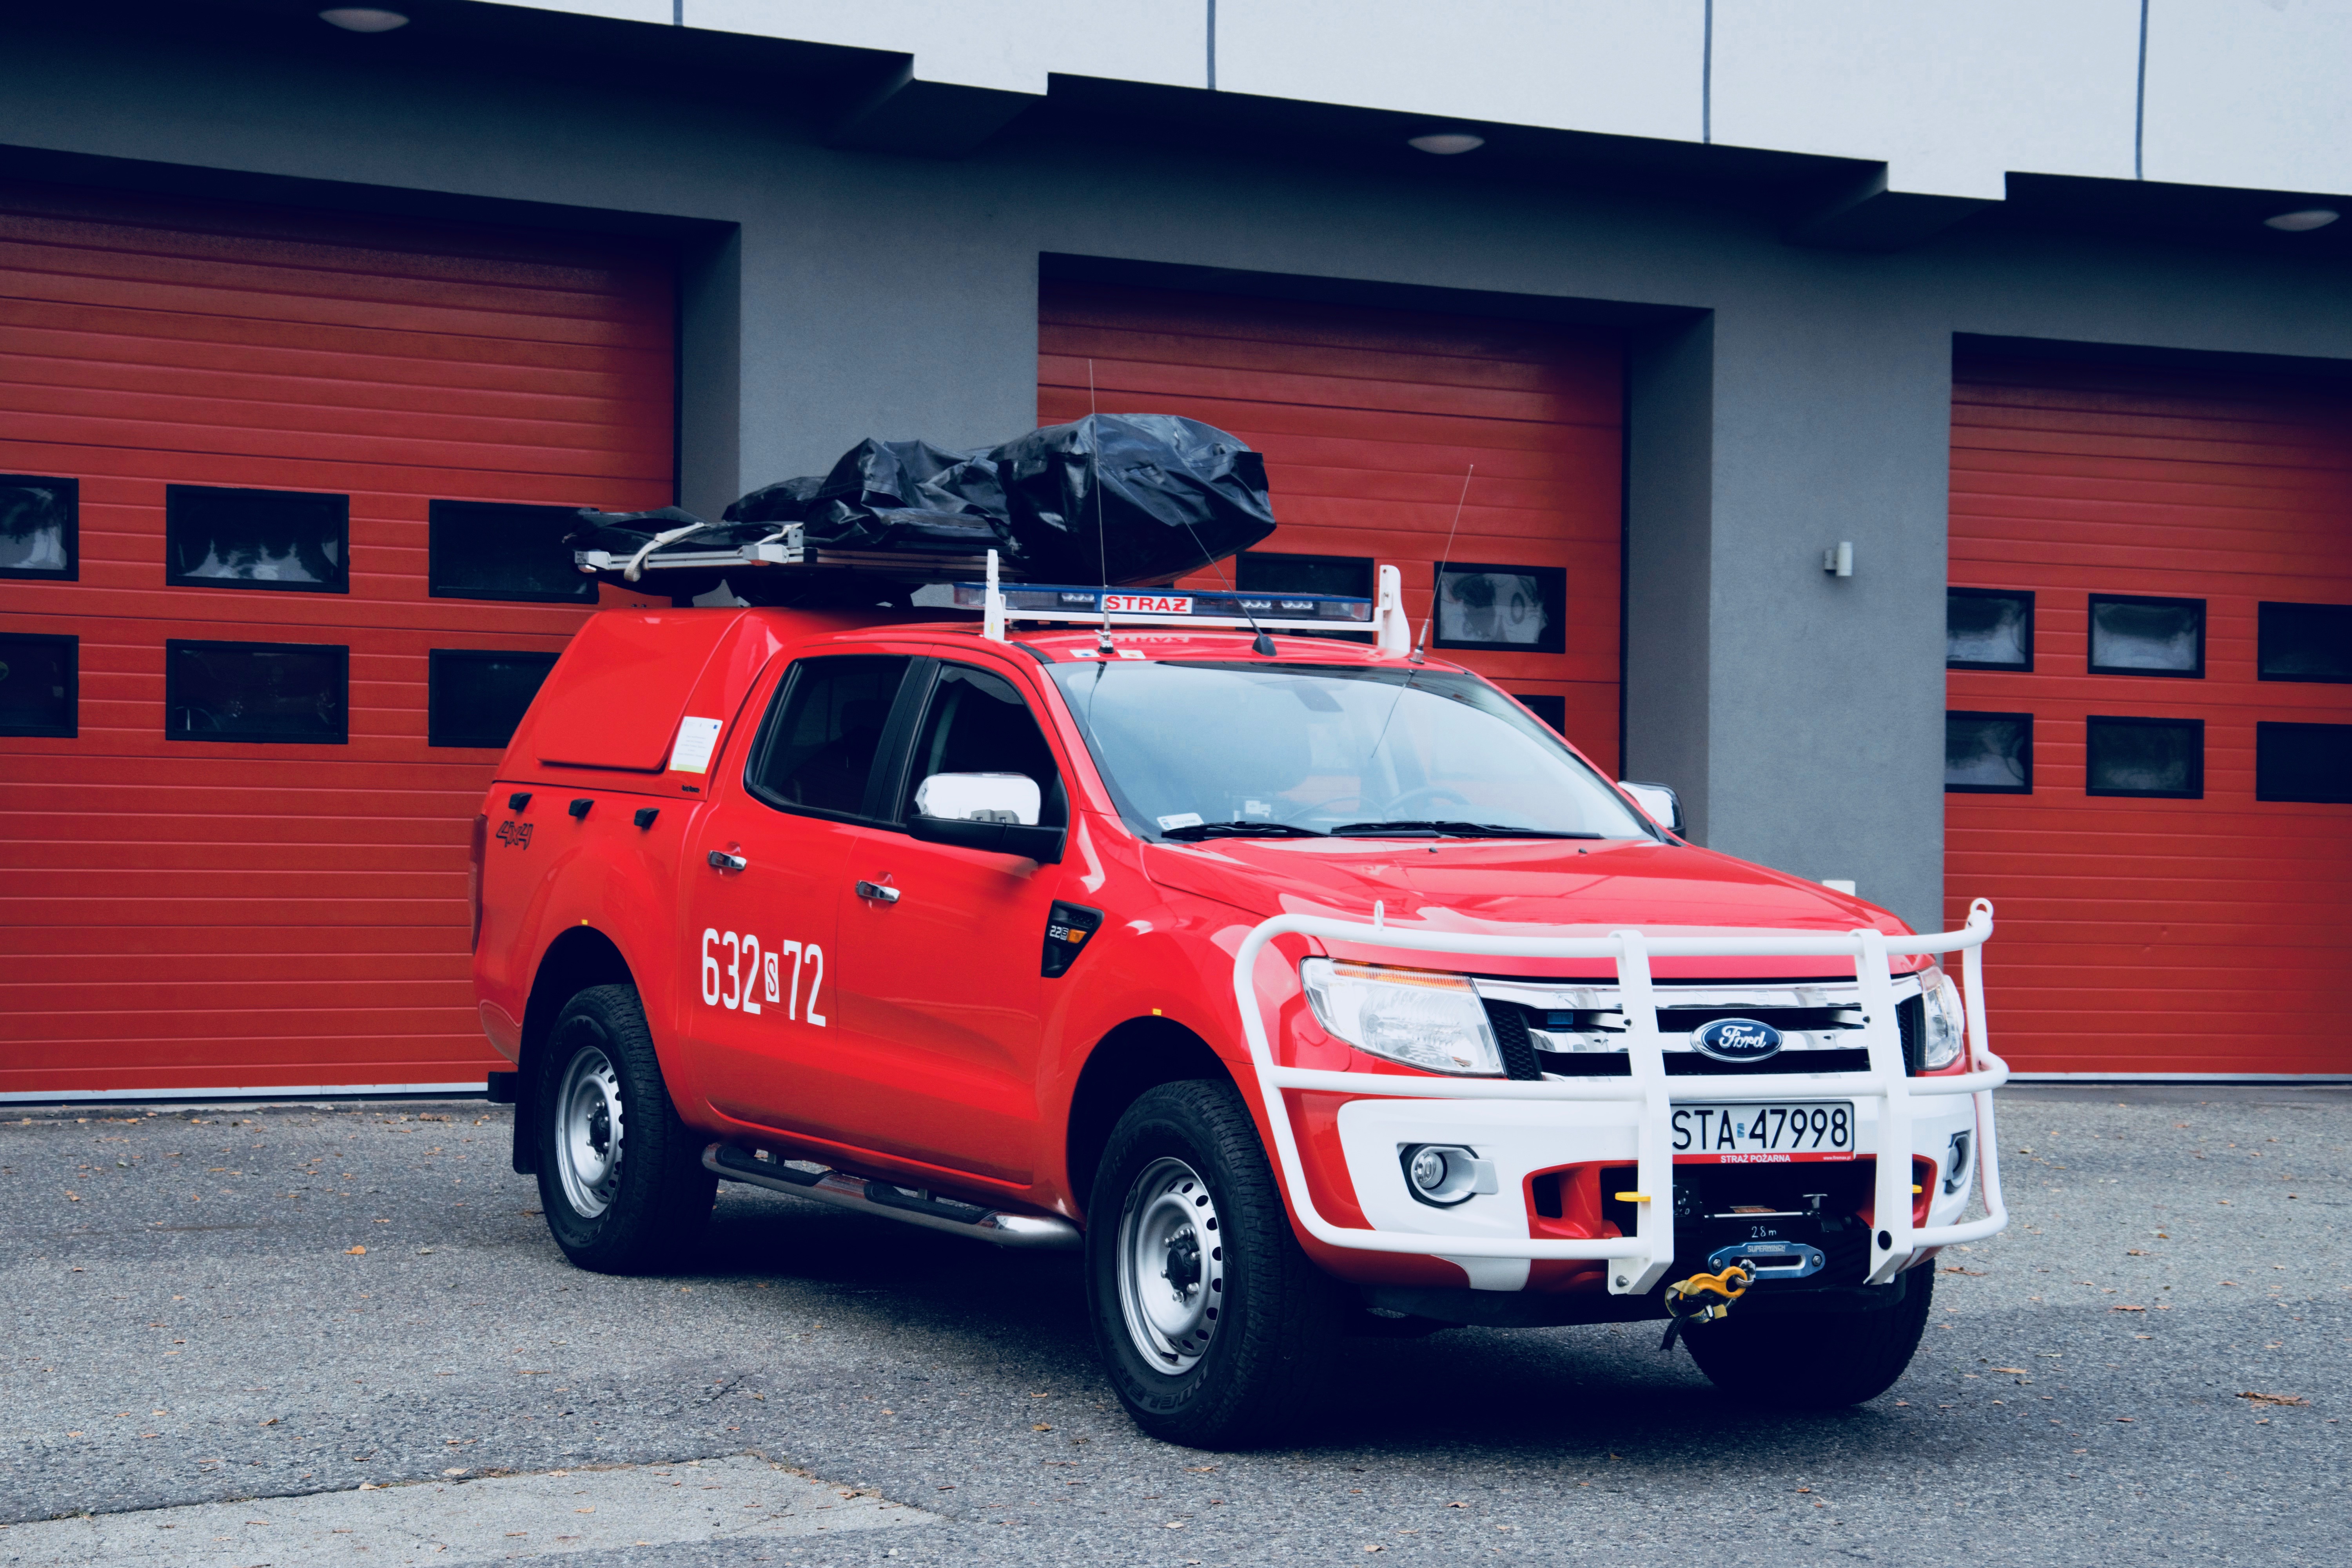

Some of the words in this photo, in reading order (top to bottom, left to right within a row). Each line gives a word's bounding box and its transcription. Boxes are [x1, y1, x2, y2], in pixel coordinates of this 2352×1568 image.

[1719, 1025, 1766, 1049] Ford
[1672, 1110, 1736, 1150] STA
[1749, 1108, 1848, 1149] 47998
[1721, 1154, 1748, 1163] STRAŻ
[1750, 1154, 1791, 1163] POŻARNA
[1751, 1226, 1766, 1238] 28
